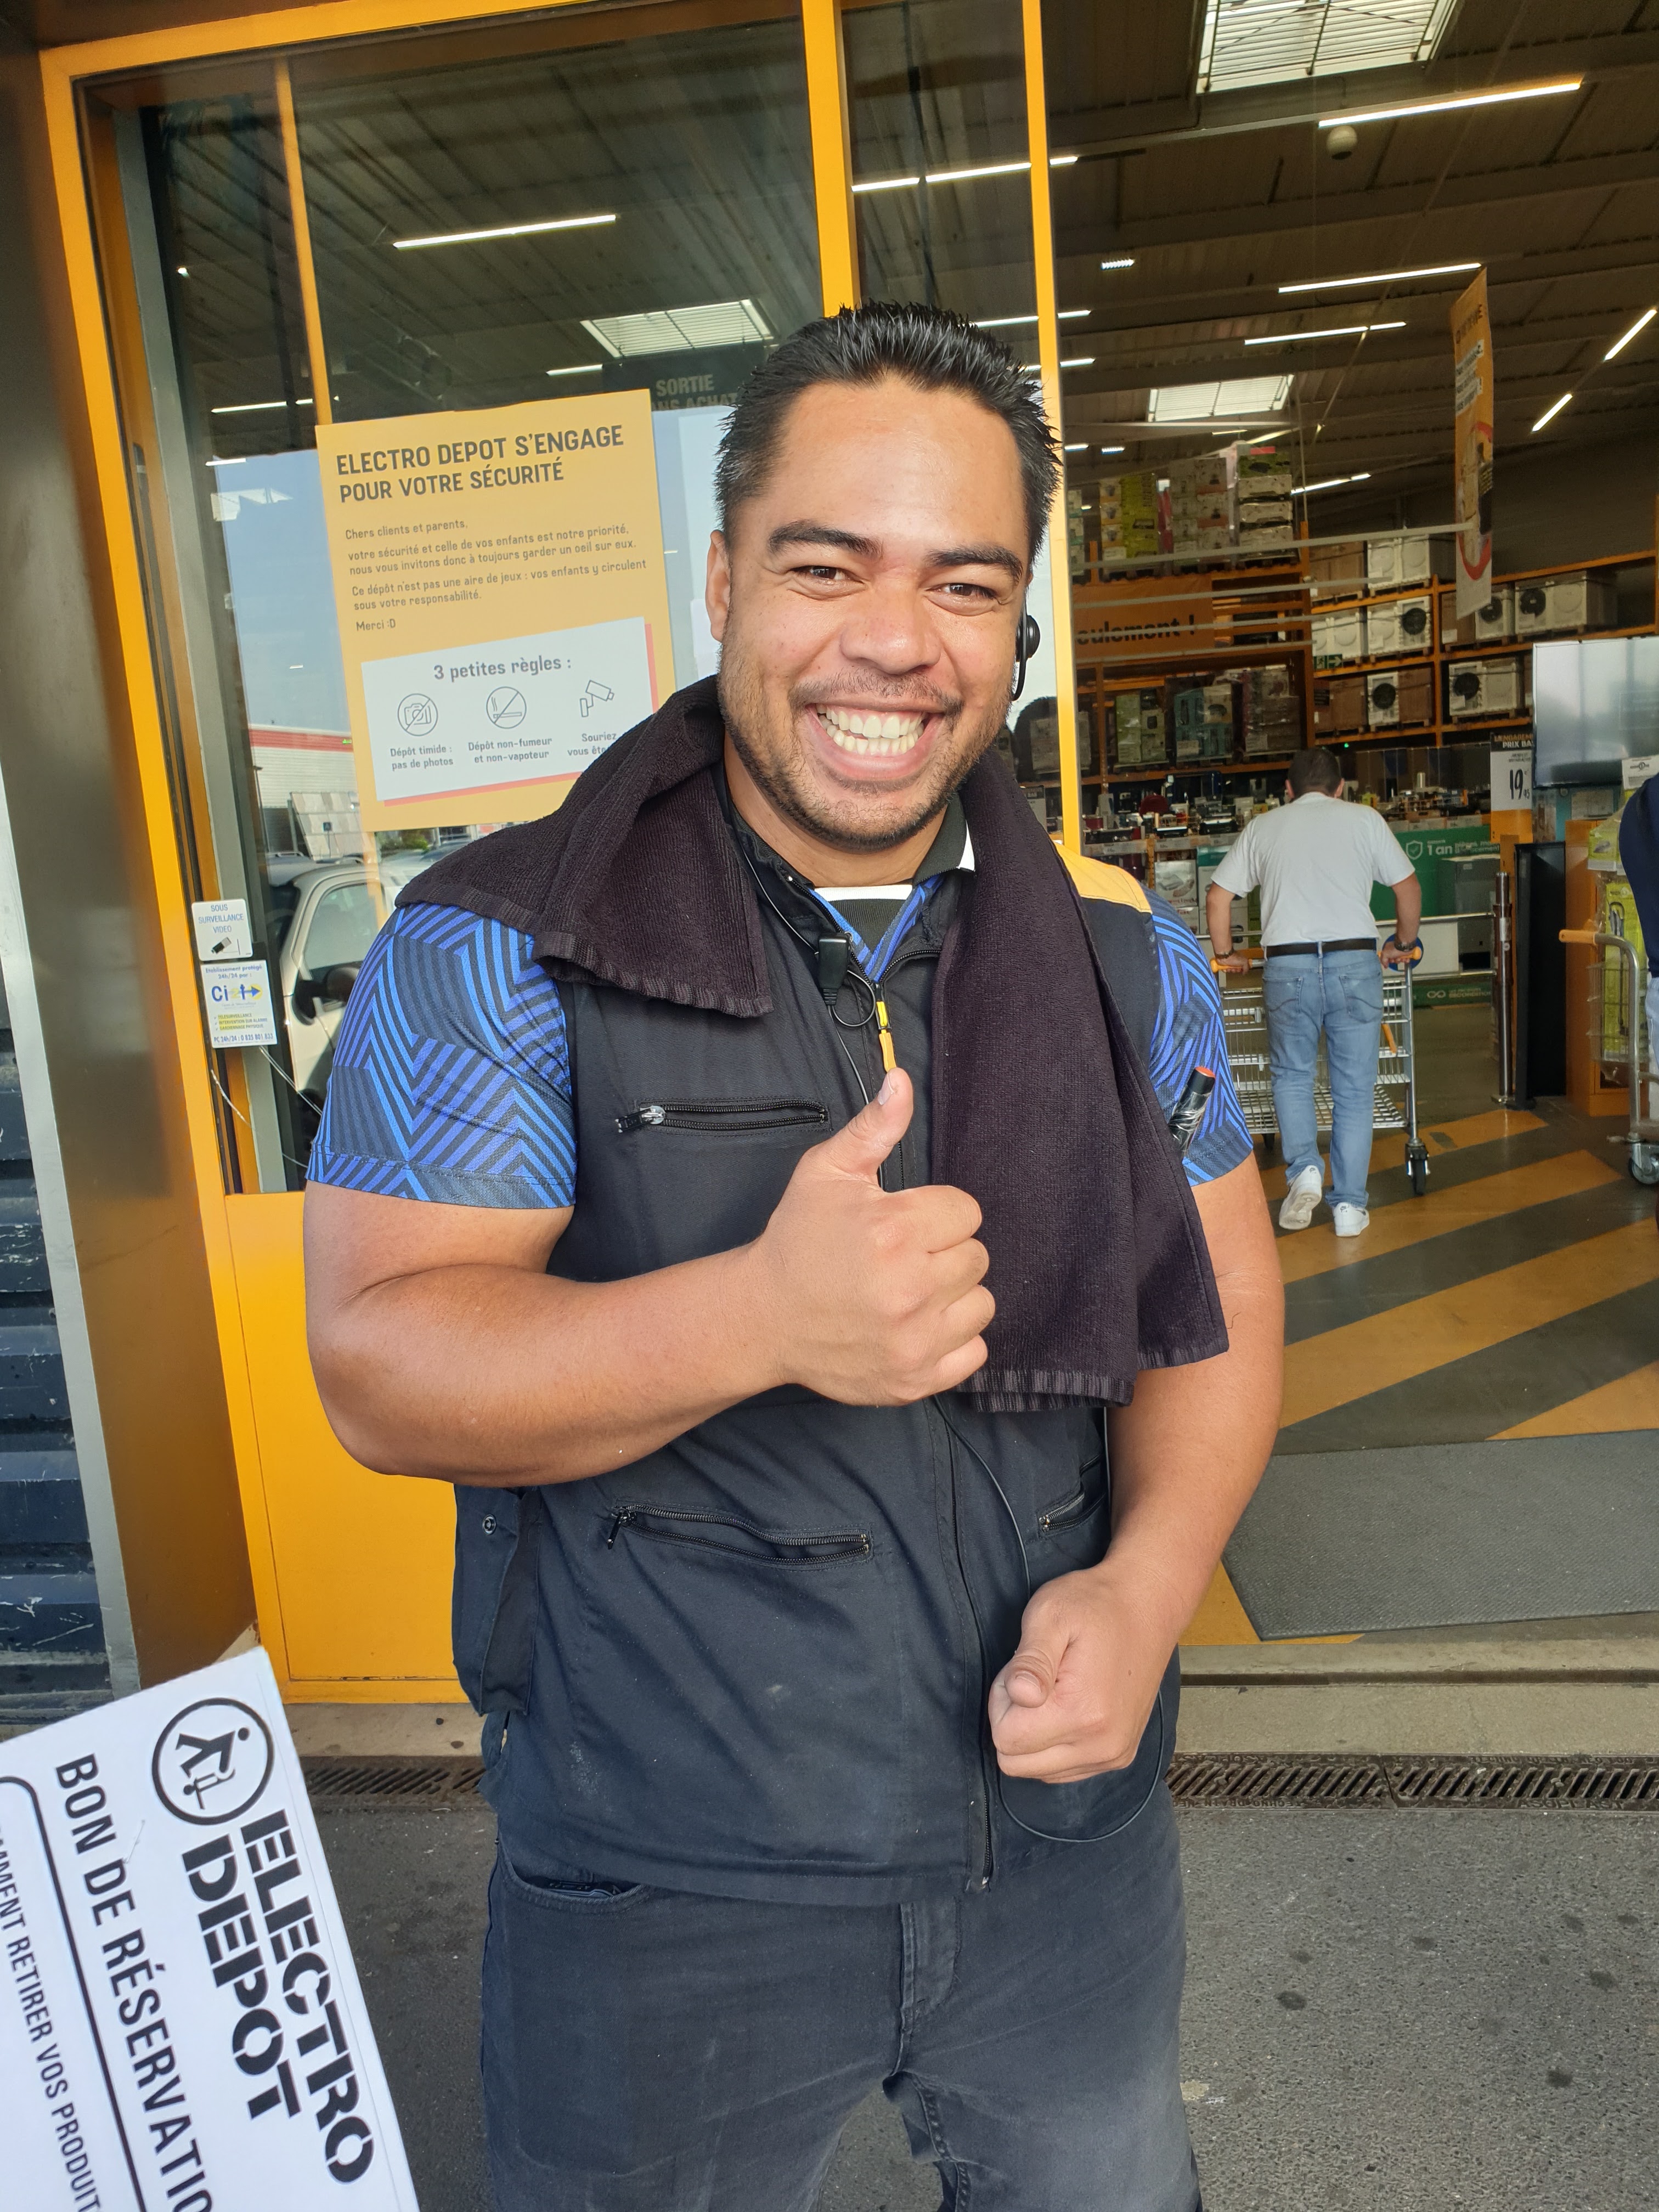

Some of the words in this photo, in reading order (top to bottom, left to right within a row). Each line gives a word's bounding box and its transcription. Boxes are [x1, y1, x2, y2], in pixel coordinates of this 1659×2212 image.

[656, 374, 714, 397] SORTIE
[337, 445, 430, 476] ELECTRO
[438, 437, 507, 466] DEPOT
[516, 425, 624, 456] S'ENGAGE
[340, 481, 392, 503] POUR
[399, 472, 464, 496] VOTRE
[470, 456, 564, 489] SÉCURITÉ
[346, 529, 374, 540] Chers
[377, 525, 410, 537] clients
[413, 523, 423, 533] et
[426, 520, 468, 534] parents,
[348, 550, 375, 561] votre
[378, 544, 419, 558] sécurité
[422, 544, 432, 554] et
[435, 540, 458, 552] celle
[461, 539, 472, 550] de
[476, 538, 493, 548] vos
[496, 534, 534, 546] enfants
[537, 532, 554, 542] est
[557, 528, 584, 540] notre
[587, 523, 629, 539] priorité,
[349, 565, 373, 575] nous
[375, 563, 398, 573] vous
[401, 558, 440, 571] invitons
[443, 556, 466, 566] donc
[470, 554, 475, 563] à
[478, 550, 520, 563] toujours
[523, 546, 557, 561] garder
[560, 547, 572, 555] un
[574, 541, 592, 553] oeil
[595, 542, 612, 551] sur
[615, 540, 636, 549] eux.
[352, 586, 364, 596] Ce
[368, 583, 394, 596] dépôt
[397, 582, 421, 592] n'est
[424, 581, 440, 591] pas
[443, 577, 461, 587] une
[465, 575, 483, 585] aire
[487, 573, 498, 584] de
[501, 572, 522, 585] jeux
[531, 569, 548, 579] vos
[551, 565, 590, 577] enfants
[592, 566, 599, 575] y
[601, 559, 647, 572] circulent
[354, 600, 376, 611] sous
[380, 597, 406, 608] votre
[409, 589, 482, 606] responsabilité.
[356, 620, 385, 631] Merci
[387, 618, 396, 628] :D
[433, 664, 444, 680] 3
[450, 661, 506, 682] petites
[511, 655, 562, 676] règles
[468, 740, 494, 754] Dépôt
[497, 737, 552, 750] non-fumeur
[582, 732, 617, 742] Souriez
[390, 746, 416, 758] Dépôt
[419, 744, 447, 755] timide
[474, 754, 483, 764] et
[487, 751, 549, 763] non-vapoteur
[592, 746, 606, 754] ête
[392, 761, 408, 771] pas
[410, 759, 421, 769] de
[423, 757, 454, 769] photos
[1510, 769, 1523, 800] 19
[1436, 846, 1453, 855] an
[198, 913, 244, 924] SURVEILLANCE
[211, 904, 228, 912] SOUS
[213, 926, 232, 934] VIDEO
[55, 1753, 116, 1856] BON
[84, 1857, 136, 1927] DE
[182, 1833, 302, 2119] DEPOT
[240, 1809, 374, 2184] ELECTRO
[7, 1935, 53, 2042] RETIRER
[36, 2044, 68, 2098] VOS
